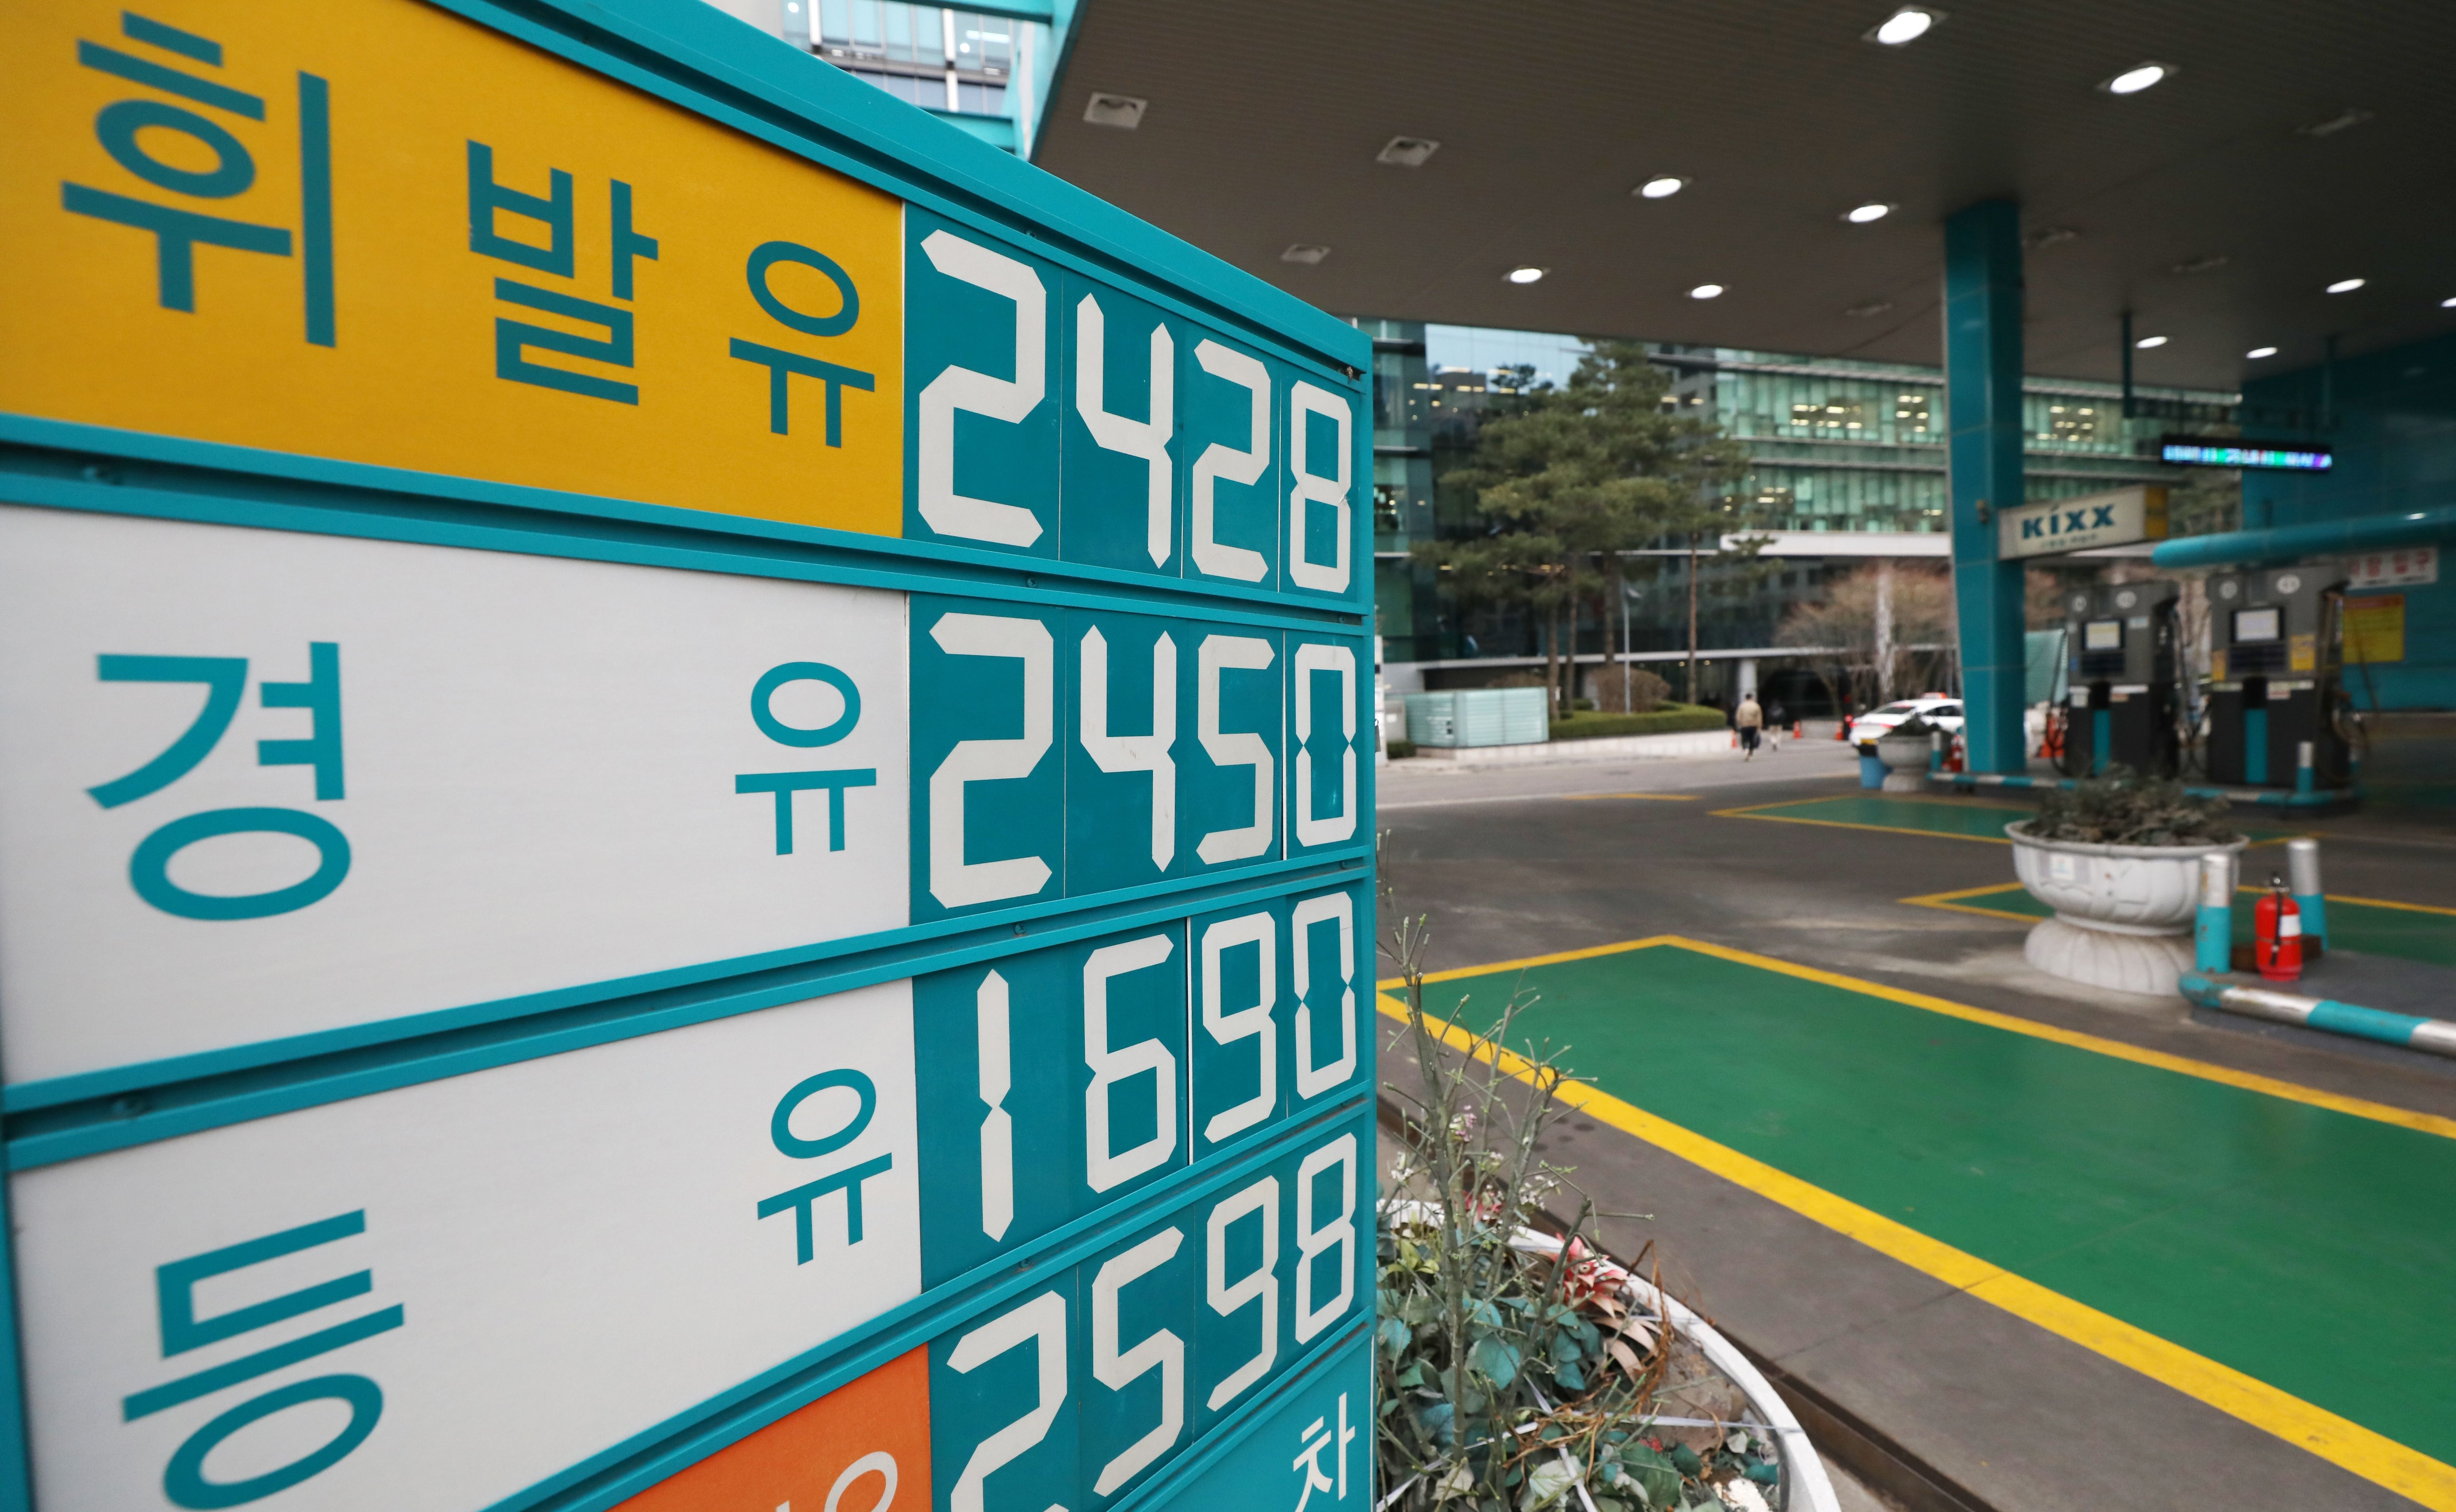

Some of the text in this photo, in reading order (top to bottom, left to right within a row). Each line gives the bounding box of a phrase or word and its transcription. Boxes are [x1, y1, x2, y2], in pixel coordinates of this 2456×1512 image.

[60, 10, 875, 449] 휘발유
[918, 229, 1352, 593] 2428
[84, 641, 877, 921] 경유
[929, 612, 1356, 909] 2450
[977, 891, 1356, 1242] 1690
[121, 1068, 893, 1512] 등유
[947, 1132, 1357, 1512] 2598
[1293, 1392, 1355, 1512] 차
